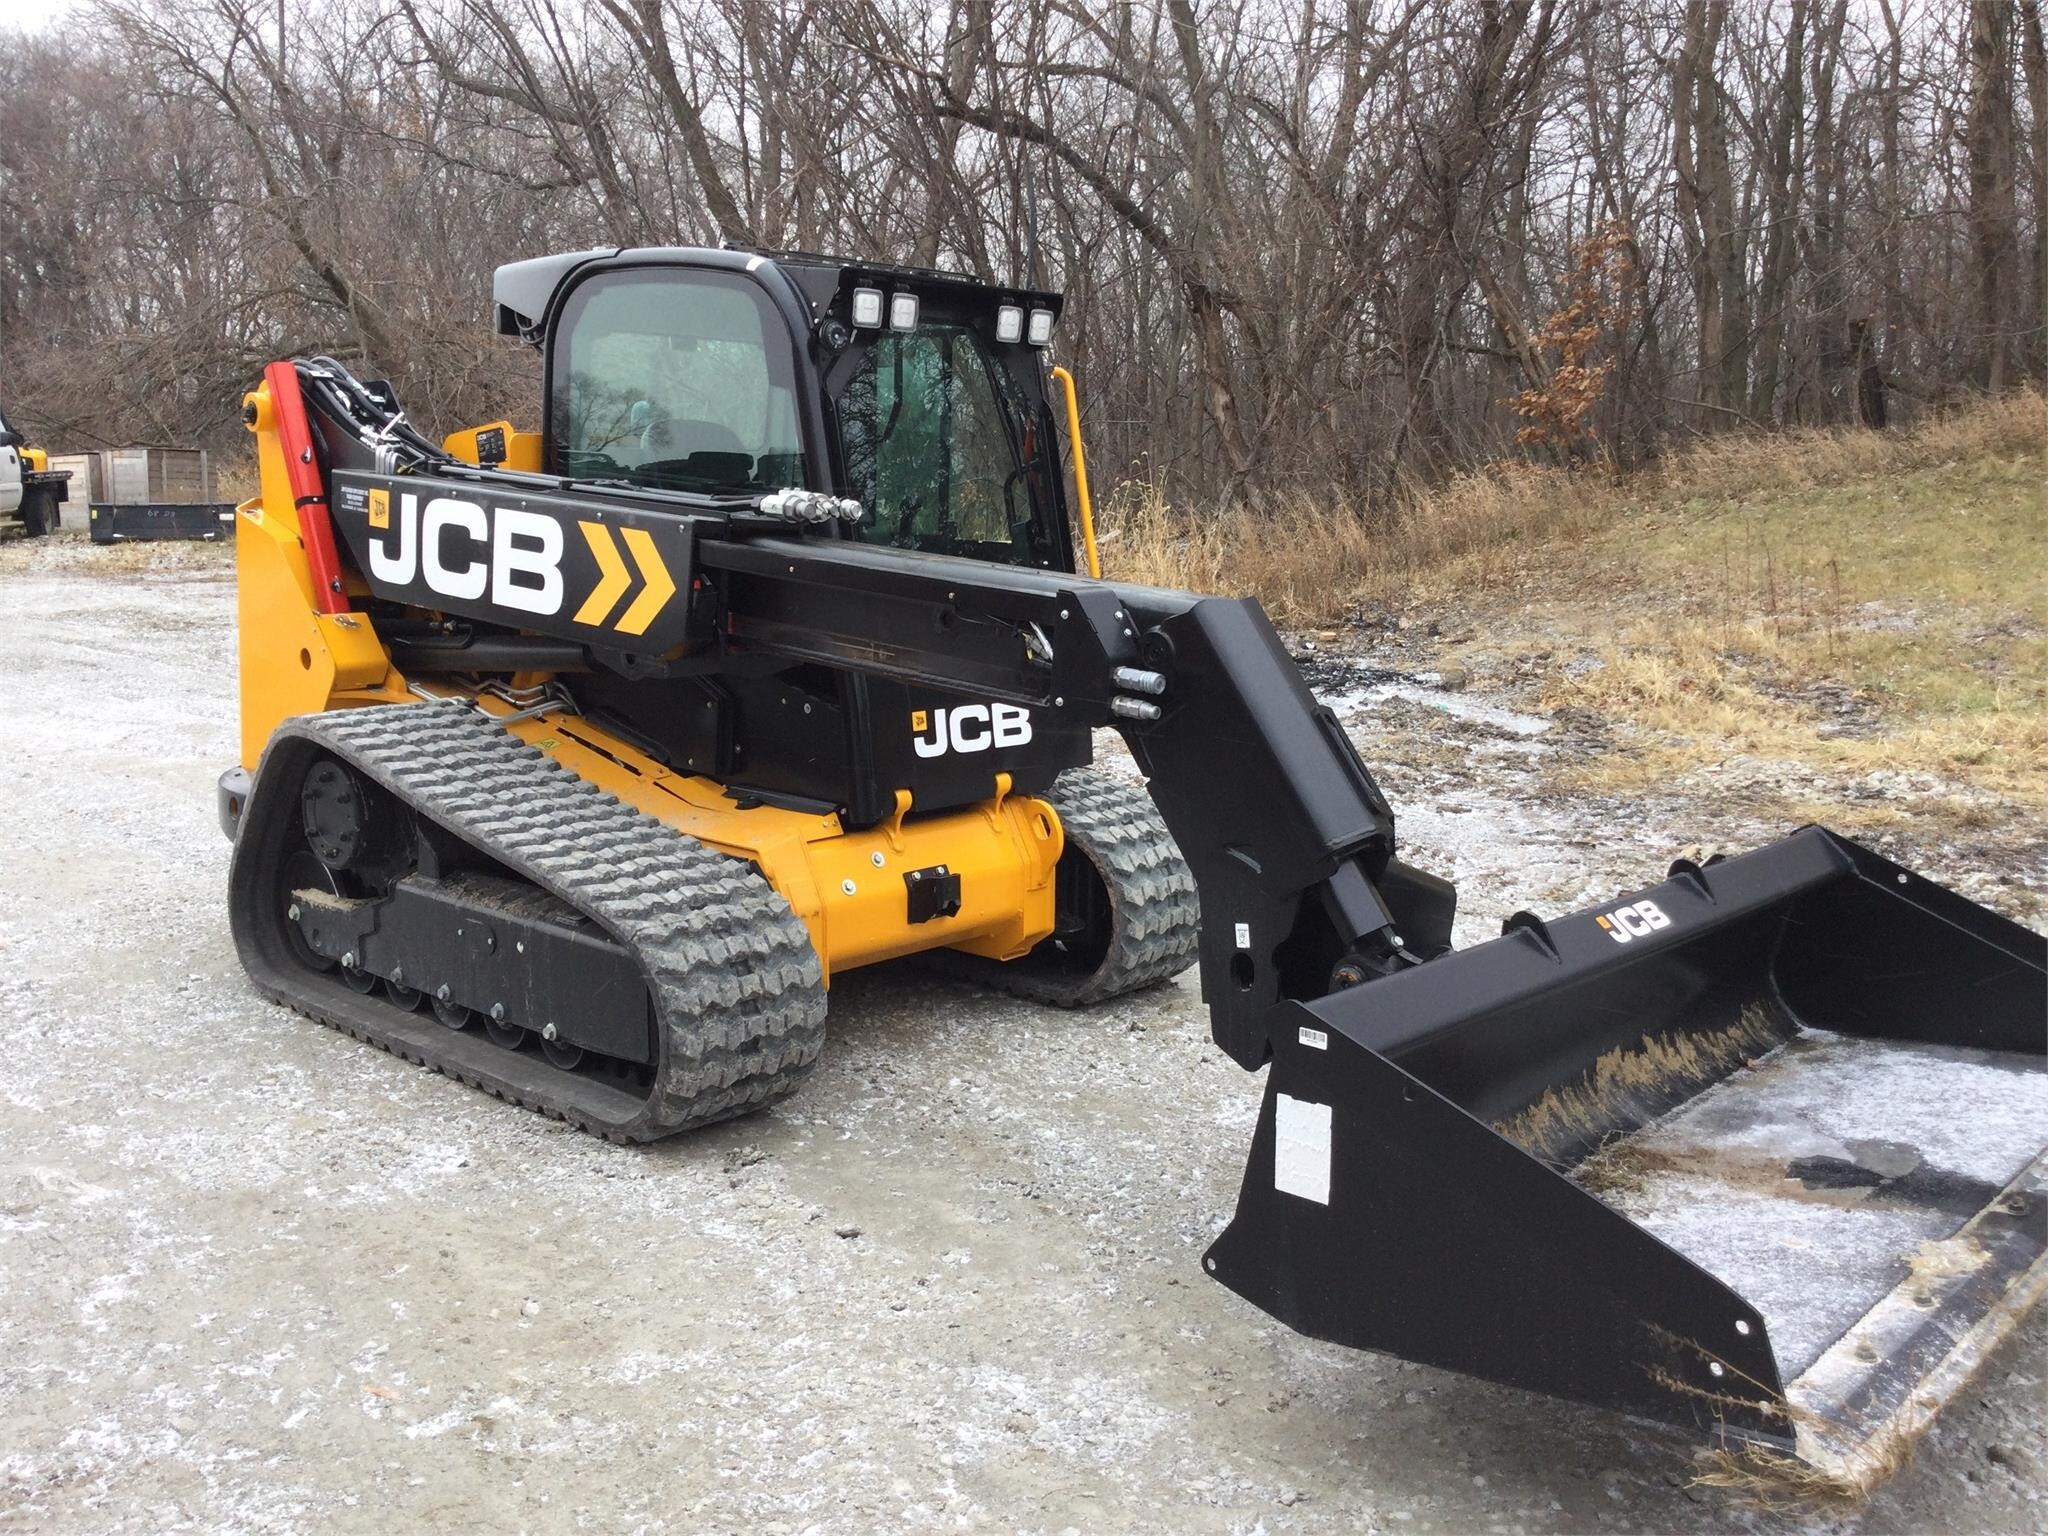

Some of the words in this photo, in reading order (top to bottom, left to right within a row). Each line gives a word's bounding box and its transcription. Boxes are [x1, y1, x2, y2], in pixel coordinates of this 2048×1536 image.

[369, 493, 563, 615] JCB
[913, 703, 1032, 758] JCB
[1605, 900, 1671, 943] JCB
